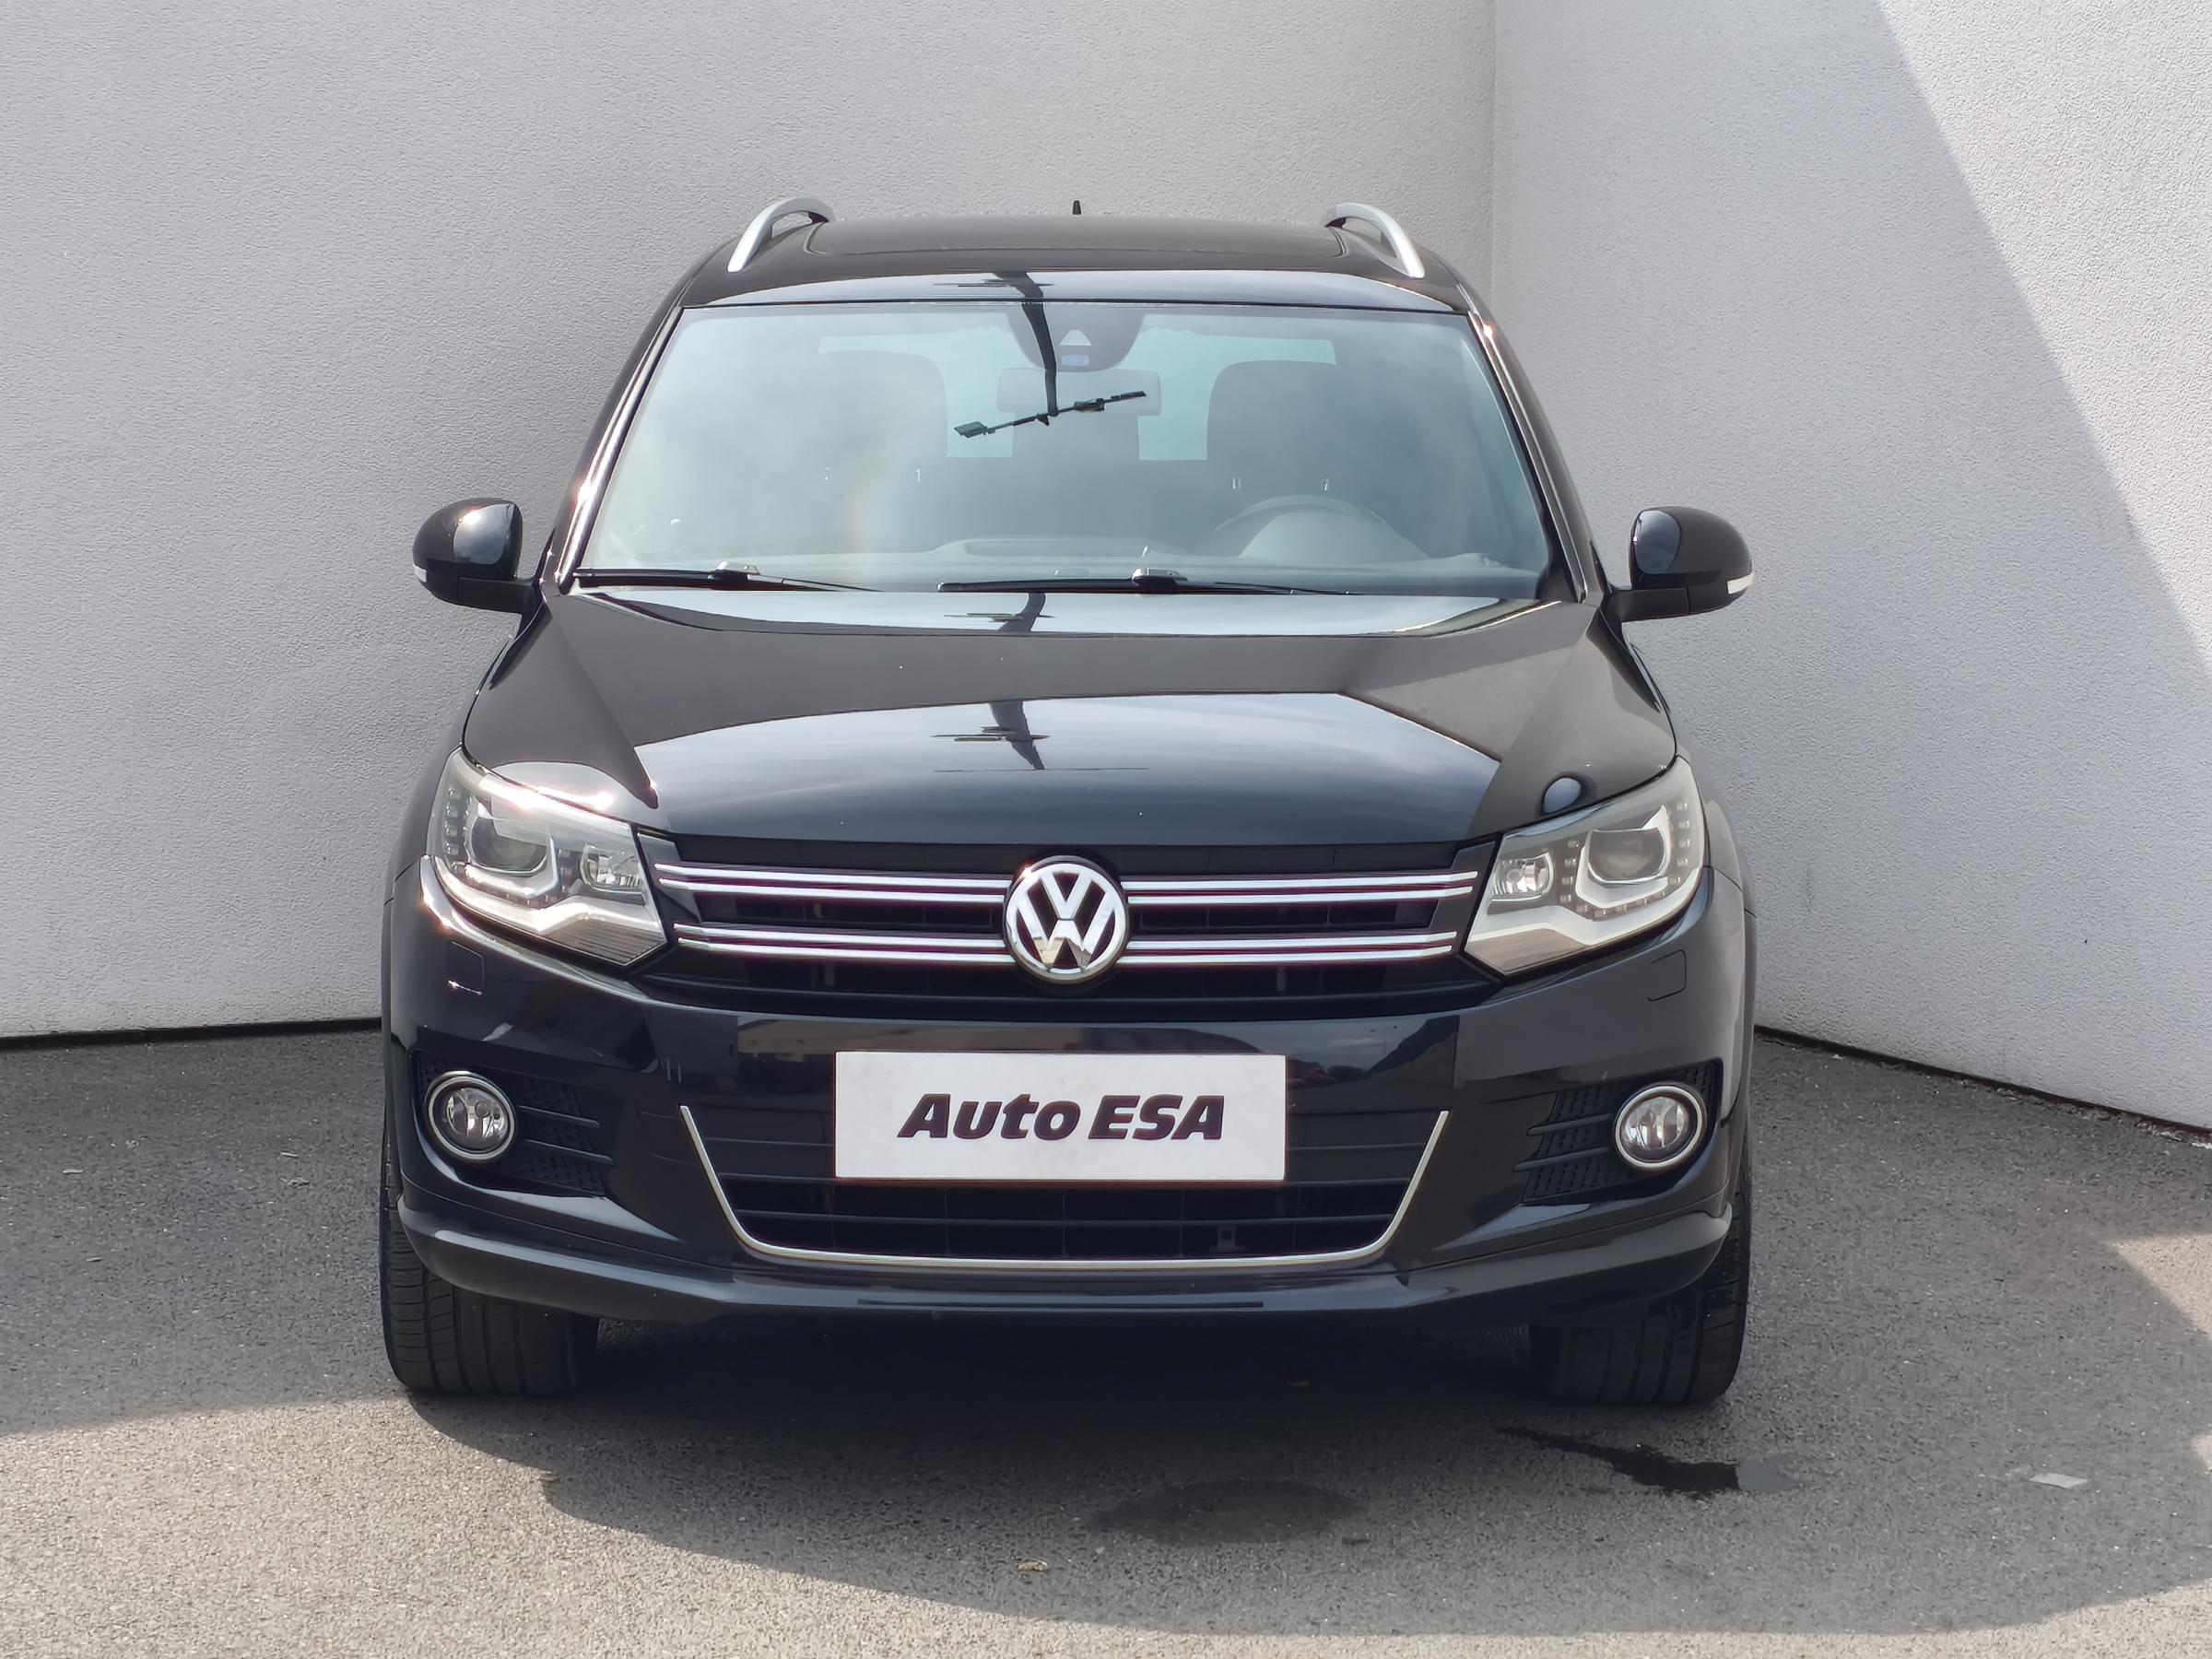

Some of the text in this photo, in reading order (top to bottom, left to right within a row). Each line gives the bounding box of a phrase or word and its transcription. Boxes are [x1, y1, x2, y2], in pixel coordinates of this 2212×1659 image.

[1011, 866, 1119, 973] VW
[897, 1093, 1224, 1141] Auto ESA
